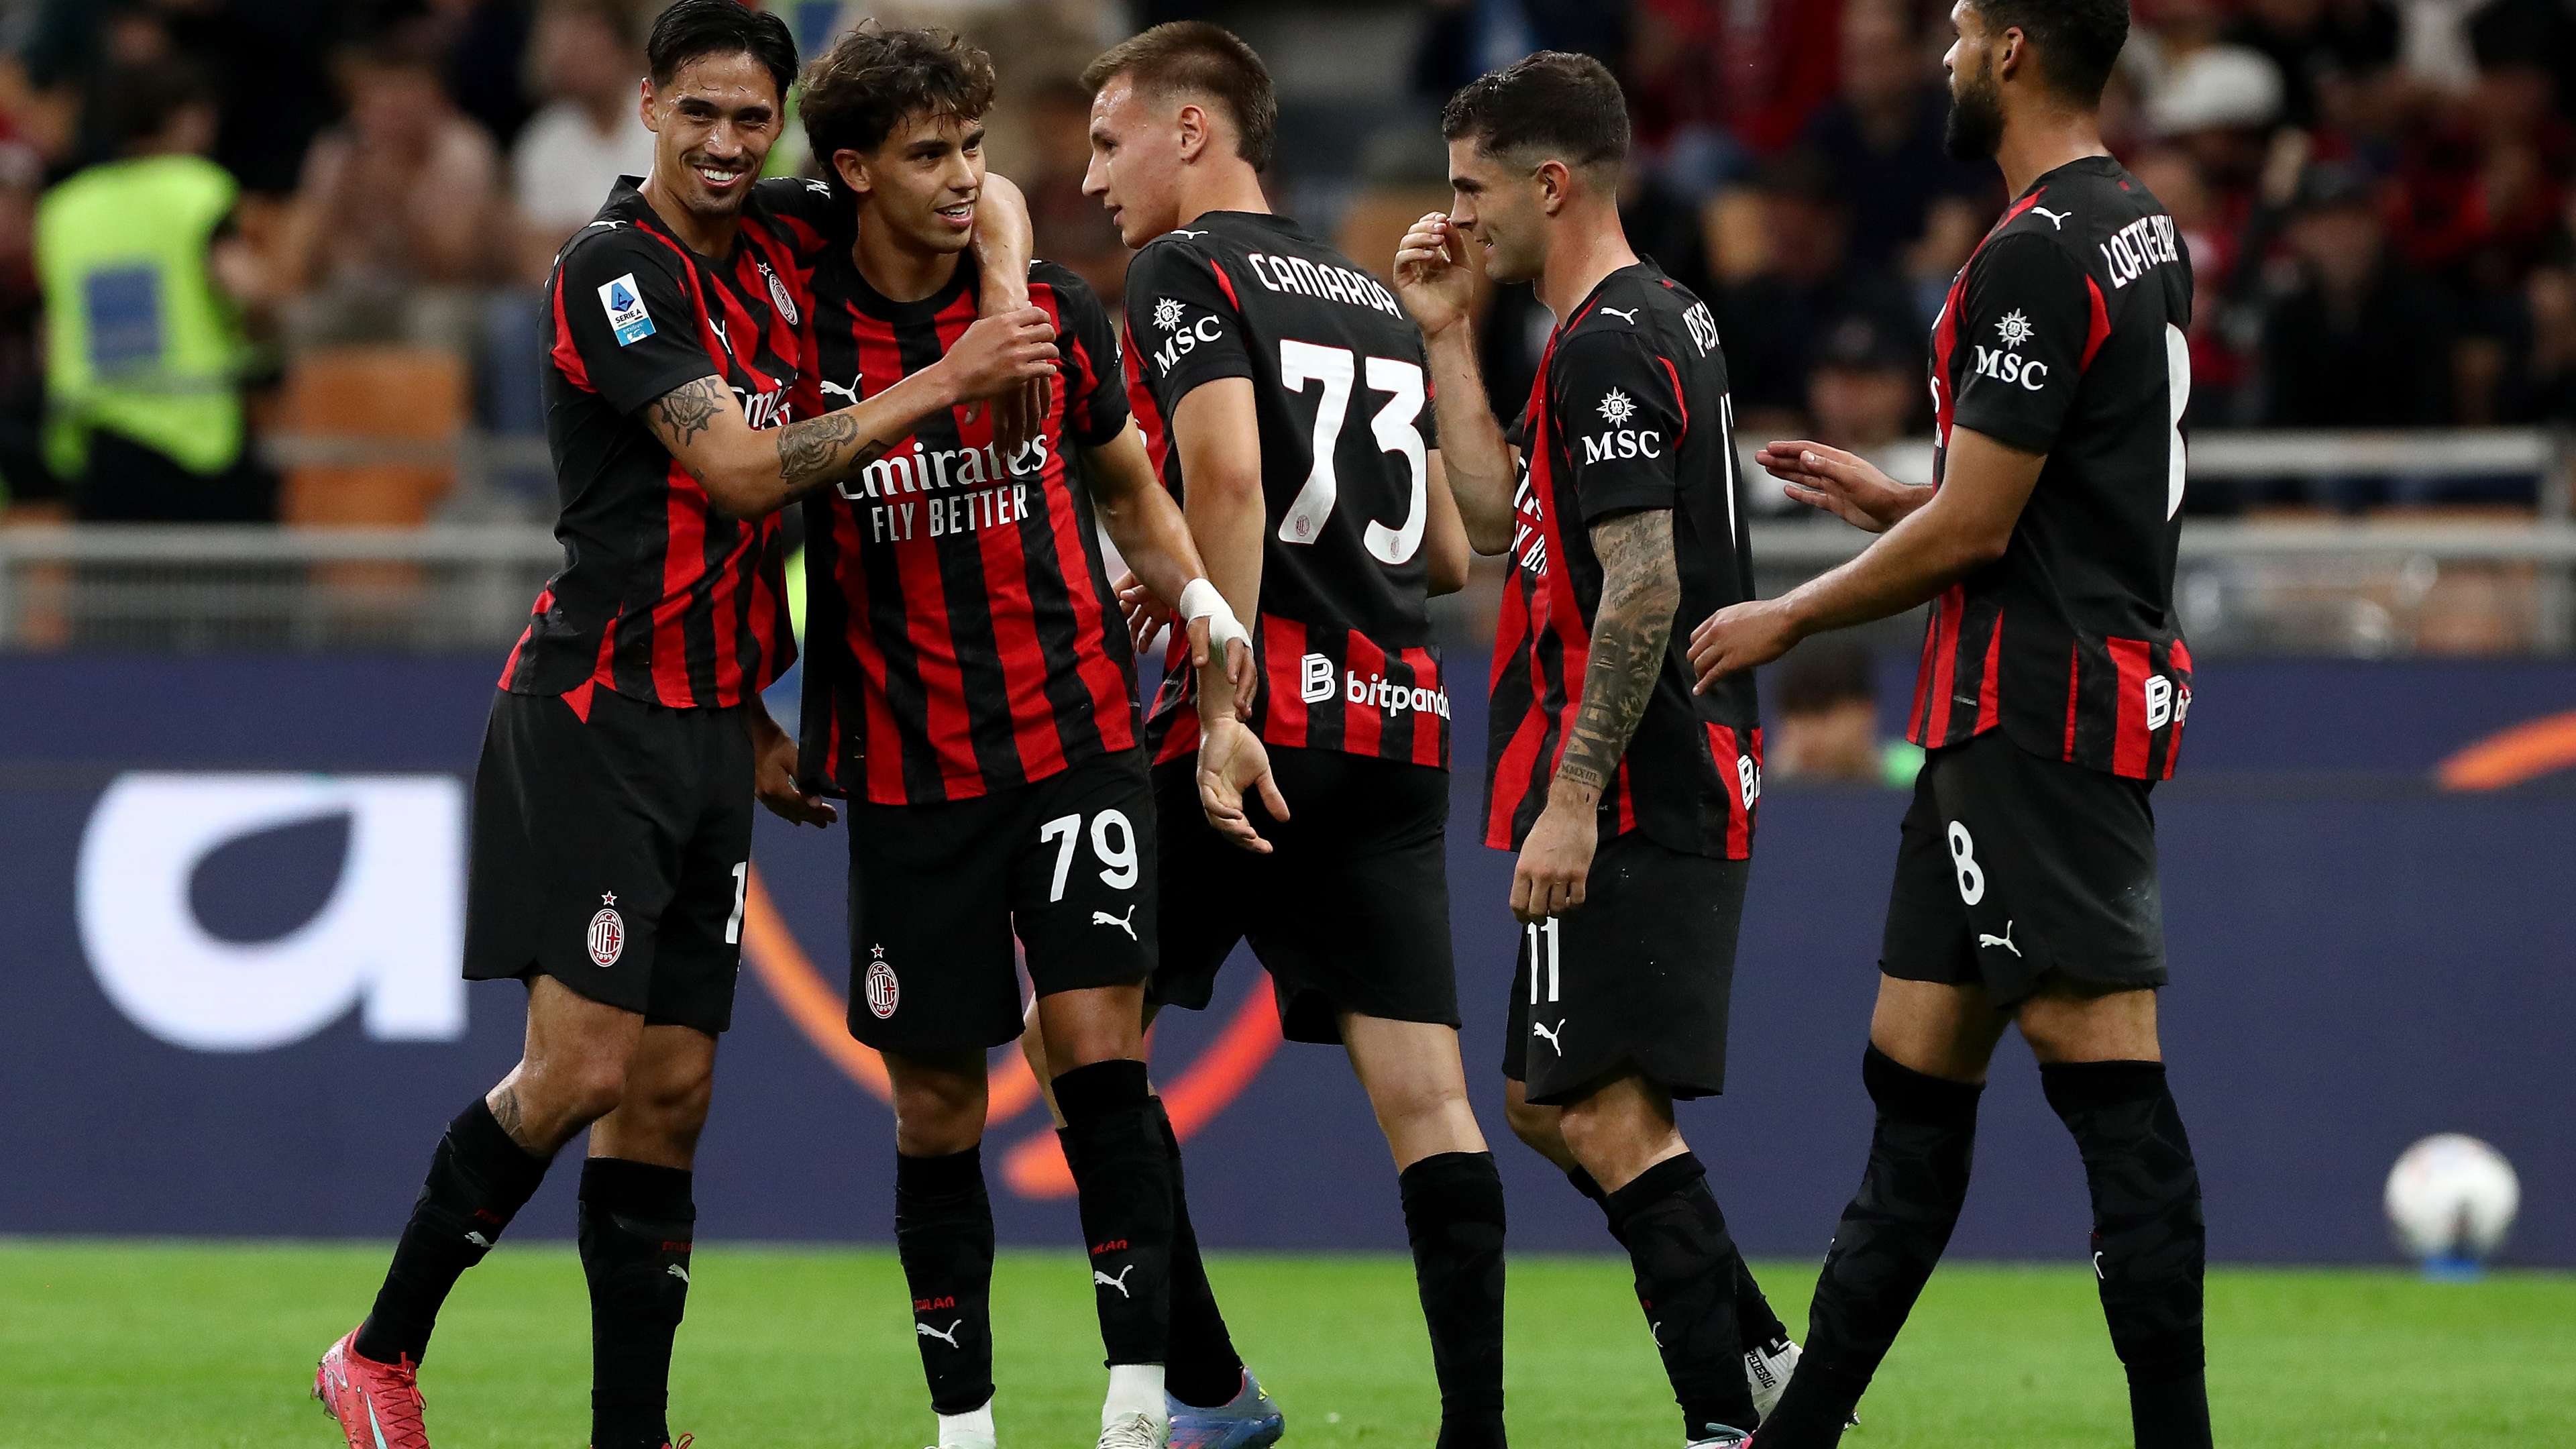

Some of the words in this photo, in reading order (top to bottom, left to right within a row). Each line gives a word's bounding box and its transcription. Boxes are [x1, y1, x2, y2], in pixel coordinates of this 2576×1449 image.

[615, 310, 636, 324] SERIE
[1247, 253, 1403, 320] CAMARDA
[1153, 314, 1222, 378] MSC
[1975, 345, 2049, 391] MSC
[836, 434, 1048, 500] mirates
[1279, 338, 1428, 566] 73
[1581, 429, 1661, 466] MSC
[872, 502, 915, 543] FLY
[928, 482, 1029, 537] BETTER
[1347, 671, 1452, 720] bitpanda
[1040, 809, 1138, 902] 79
[1948, 820, 1985, 906] 8
[597, 913, 618, 925] ACM
[596, 953, 612, 961] 1899
[872, 966, 890, 977] ACM
[1527, 916, 1559, 1005] 11
